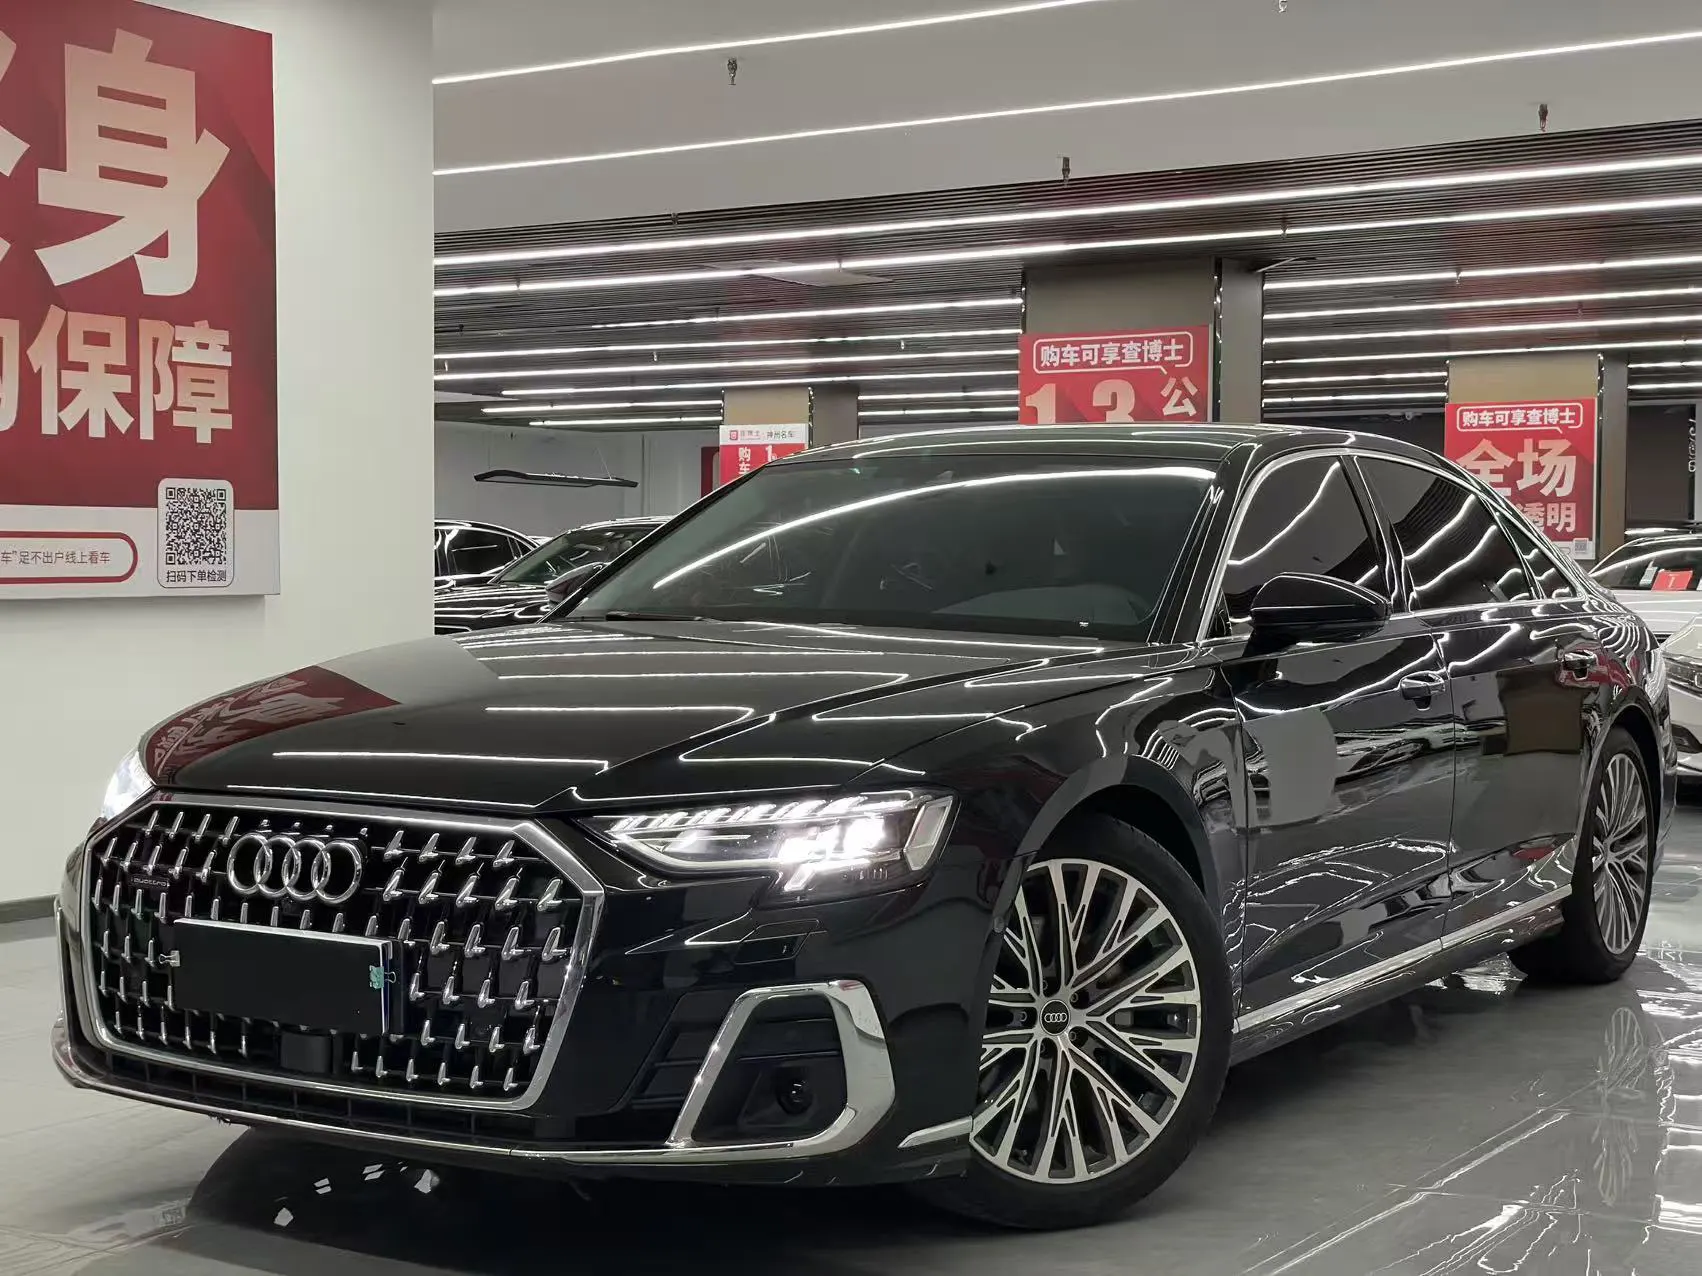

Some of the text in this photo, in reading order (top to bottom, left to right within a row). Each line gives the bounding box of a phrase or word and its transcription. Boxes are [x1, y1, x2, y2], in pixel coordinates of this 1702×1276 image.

[0, 27, 230, 296] 身
[1040, 339, 1183, 367] 购车可享查博士
[1462, 407, 1576, 427] 购车可享查博士
[1456, 438, 1577, 497] 全场
[166, 570, 227, 583] 扫码下单检测
